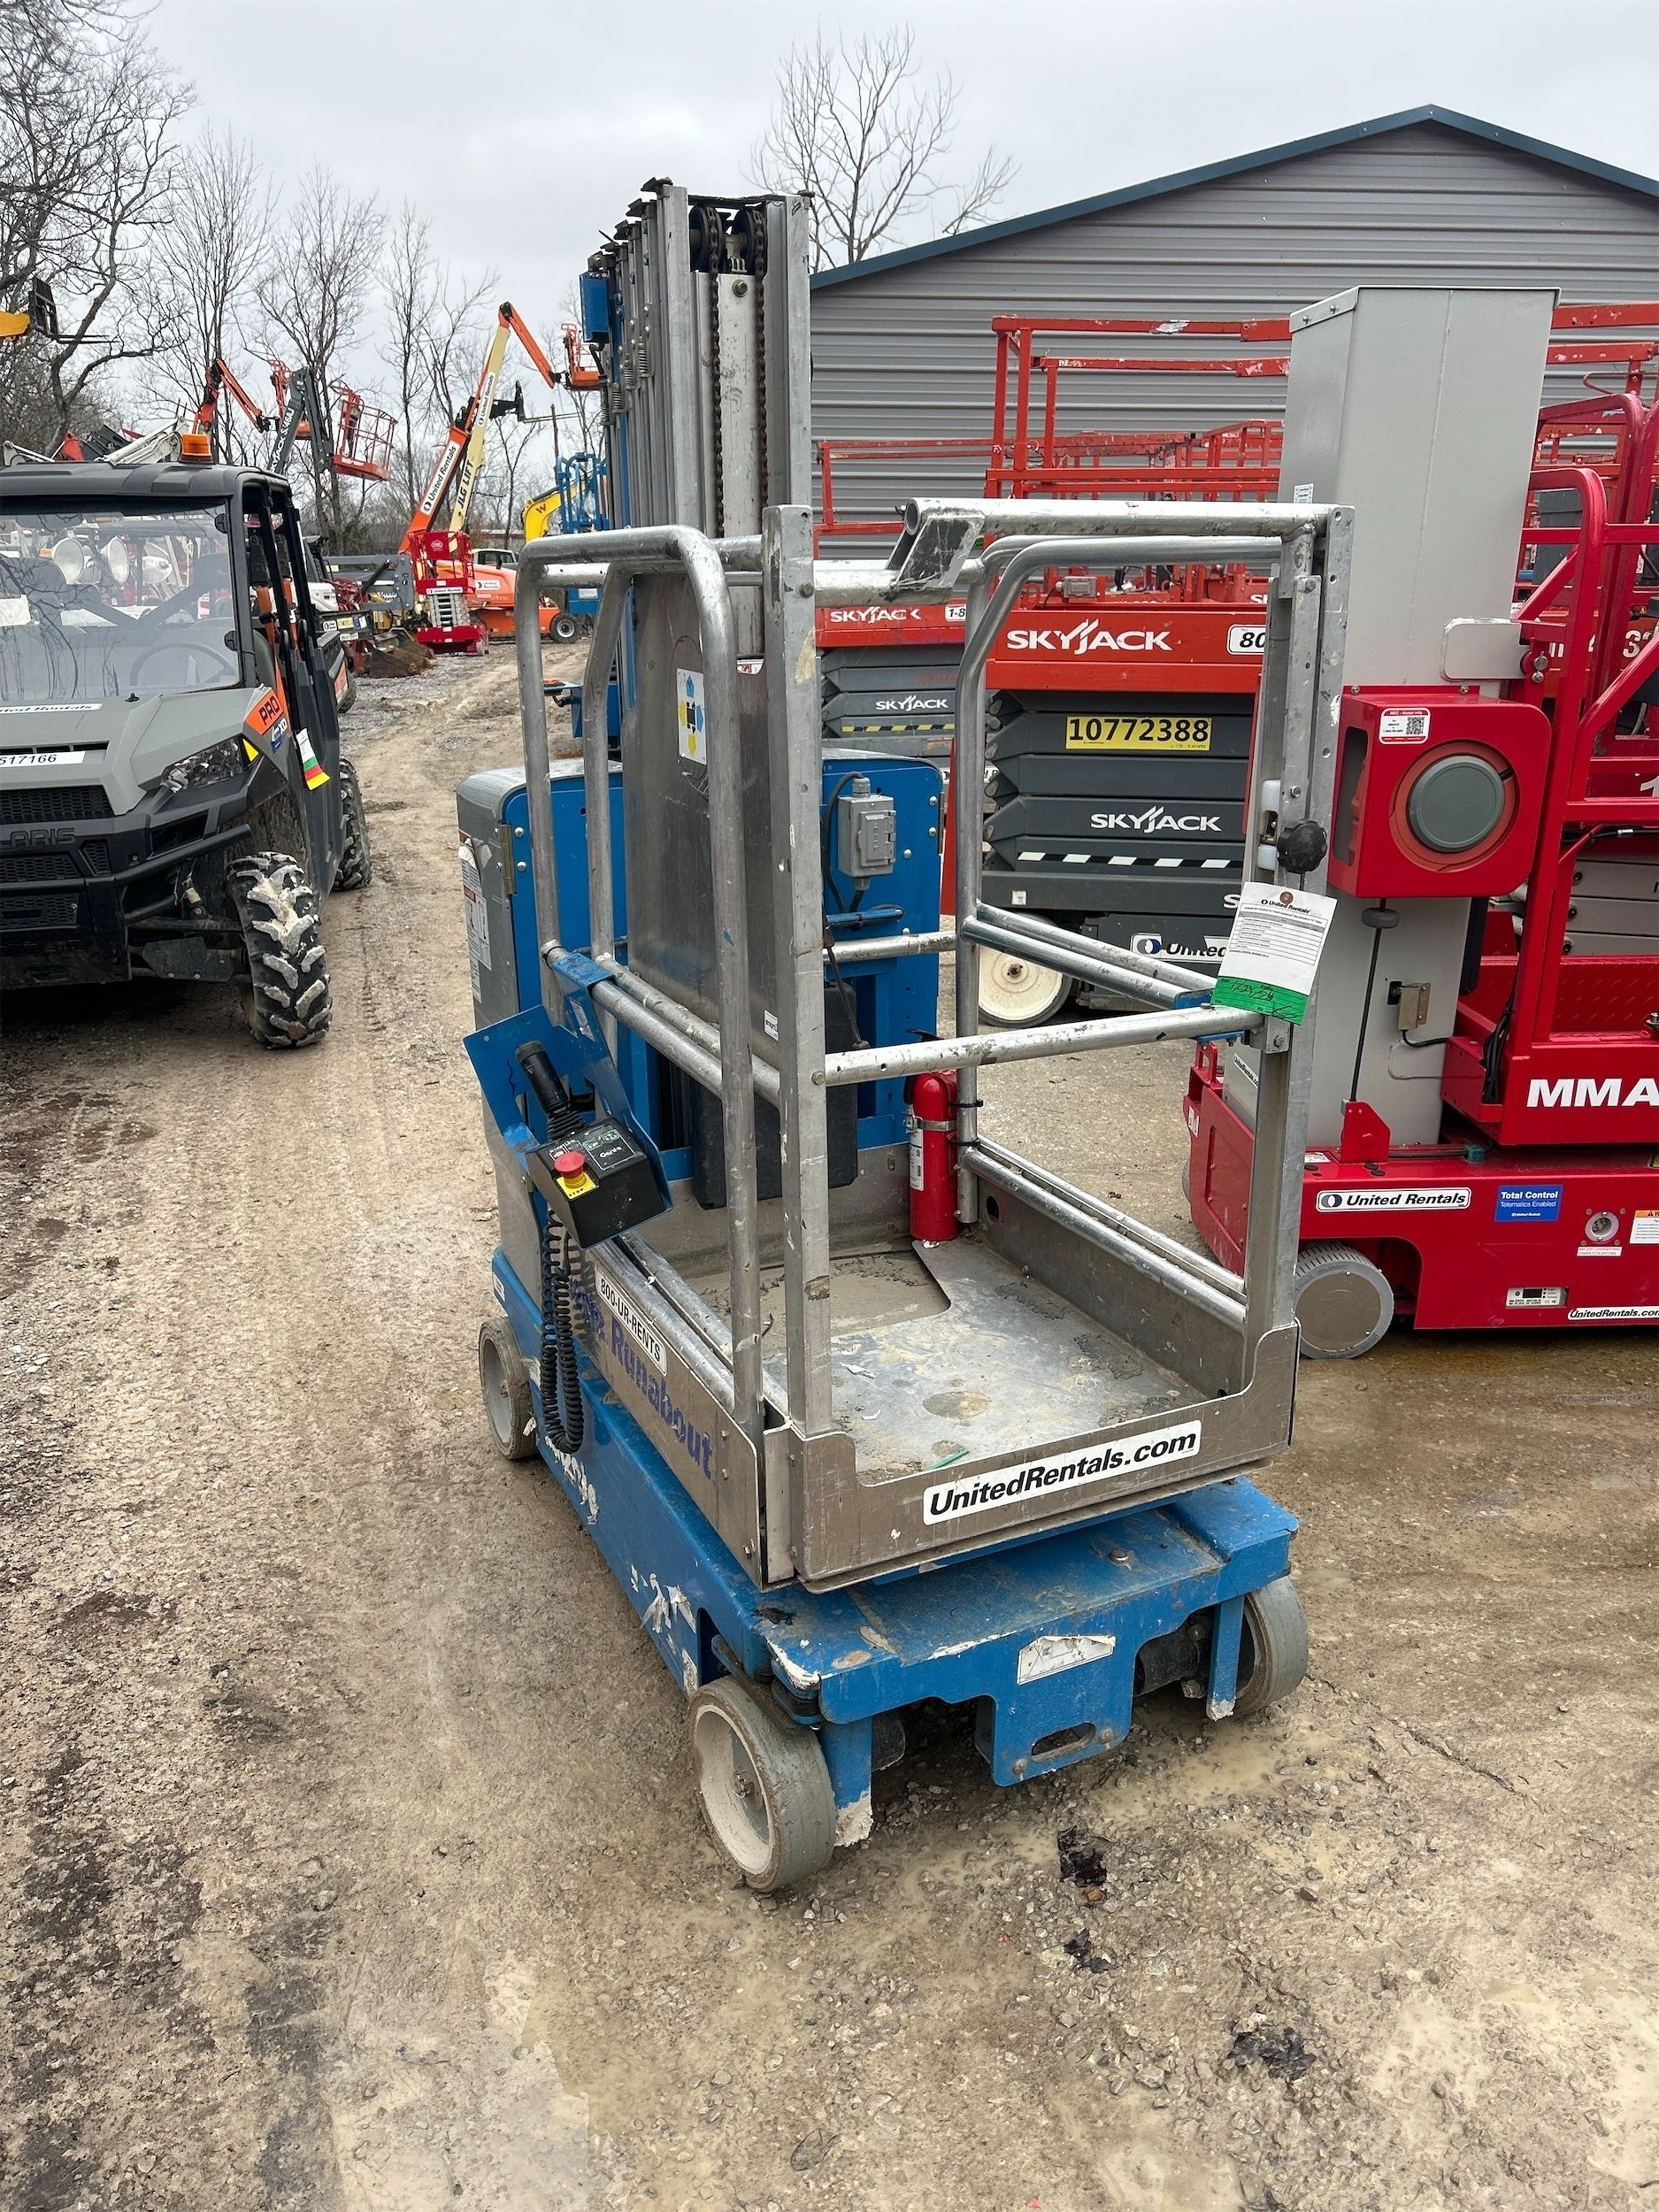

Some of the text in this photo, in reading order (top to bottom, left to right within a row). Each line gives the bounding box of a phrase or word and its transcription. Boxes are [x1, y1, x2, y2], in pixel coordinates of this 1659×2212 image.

[428, 445, 457, 502] United Rentals
[457, 459, 475, 509] JLG LIFT
[830, 606, 921, 624] SKYJACK
[1006, 618, 1173, 655] SKYJACK
[258, 695, 280, 726] PRO
[875, 695, 949, 711] SKYJACK
[1069, 718, 1210, 742] 10772388
[1090, 806, 1222, 833] SKYJACK
[1269, 900, 1288, 909] United
[569, 1187, 584, 1197] STOP
[1346, 1193, 1466, 1207] United Rentals
[1501, 1191, 1559, 1200] Total Control
[601, 1279, 661, 1363] 800-UR-RENTS
[611, 1314, 712, 1480] Runabout
[930, 1432, 1197, 1517] UnitedRentals.com
